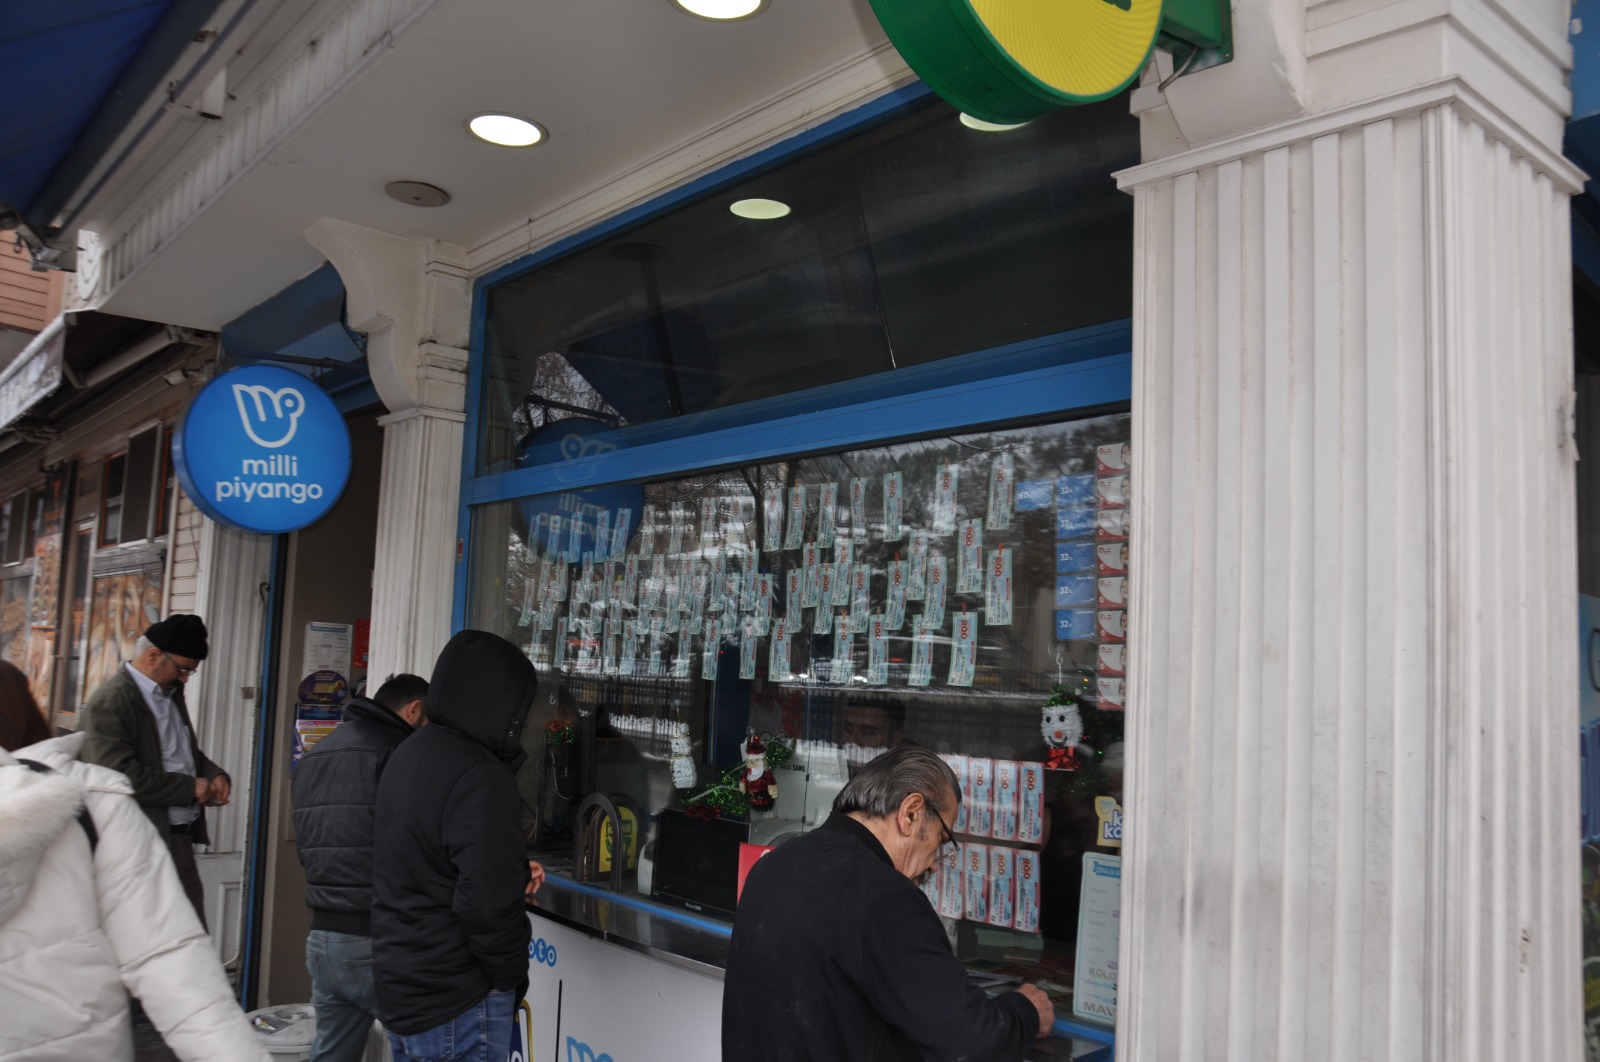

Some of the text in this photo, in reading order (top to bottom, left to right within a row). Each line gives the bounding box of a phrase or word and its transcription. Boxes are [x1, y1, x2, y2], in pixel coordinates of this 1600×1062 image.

[242, 454, 298, 476] milli
[216, 476, 323, 504] piyango
[965, 527, 973, 546] 800
[995, 557, 1003, 577] 800
[1026, 769, 1035, 791] 800
[971, 851, 979, 872] 800
[997, 854, 1005, 875] 800
[1023, 858, 1031, 880] 800
